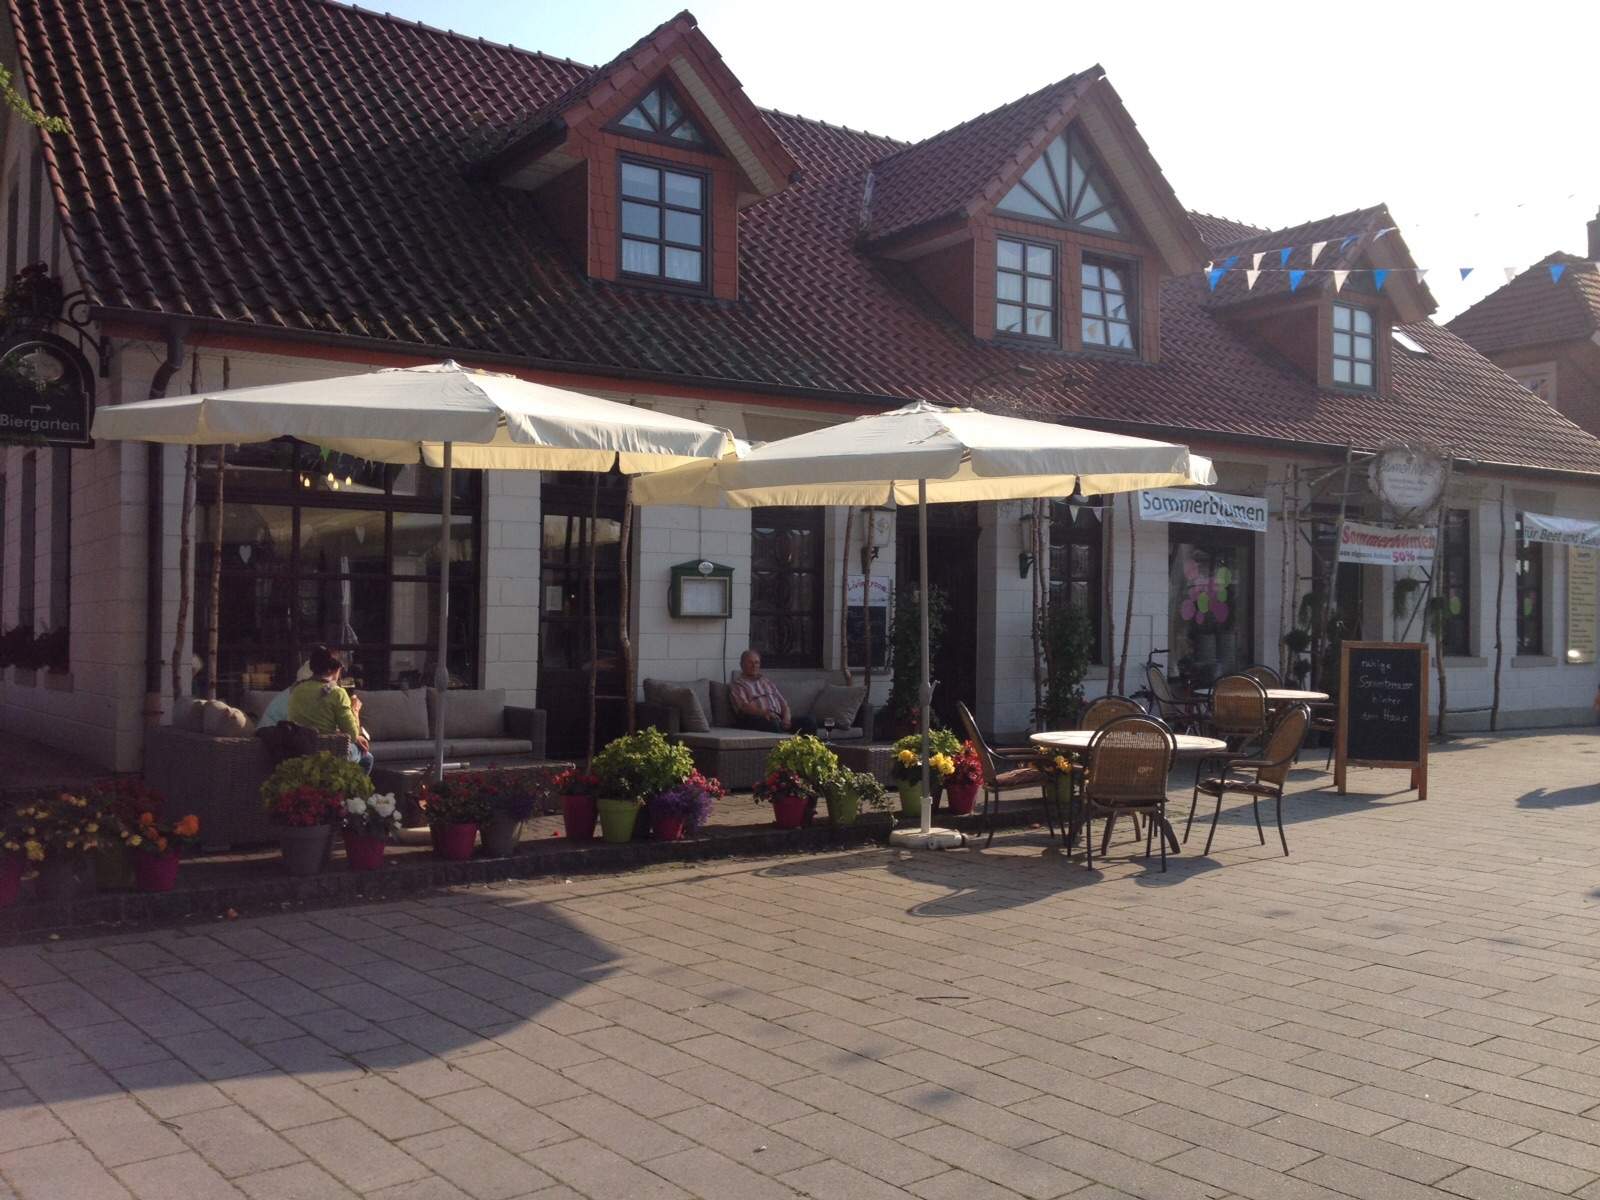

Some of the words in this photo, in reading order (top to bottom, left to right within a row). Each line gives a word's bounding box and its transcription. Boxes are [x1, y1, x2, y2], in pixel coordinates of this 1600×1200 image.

[0, 414, 80, 431] Biergarten
[1142, 491, 1265, 522] Sommerblumen
[1342, 525, 1437, 549] Sommerblumen
[1540, 528, 1562, 542] Beet
[1562, 532, 1580, 544] und
[1392, 551, 1416, 563] 50%
[1361, 659, 1391, 674] ruhige
[1372, 692, 1401, 704] hinter
[1383, 708, 1408, 722] Haus
